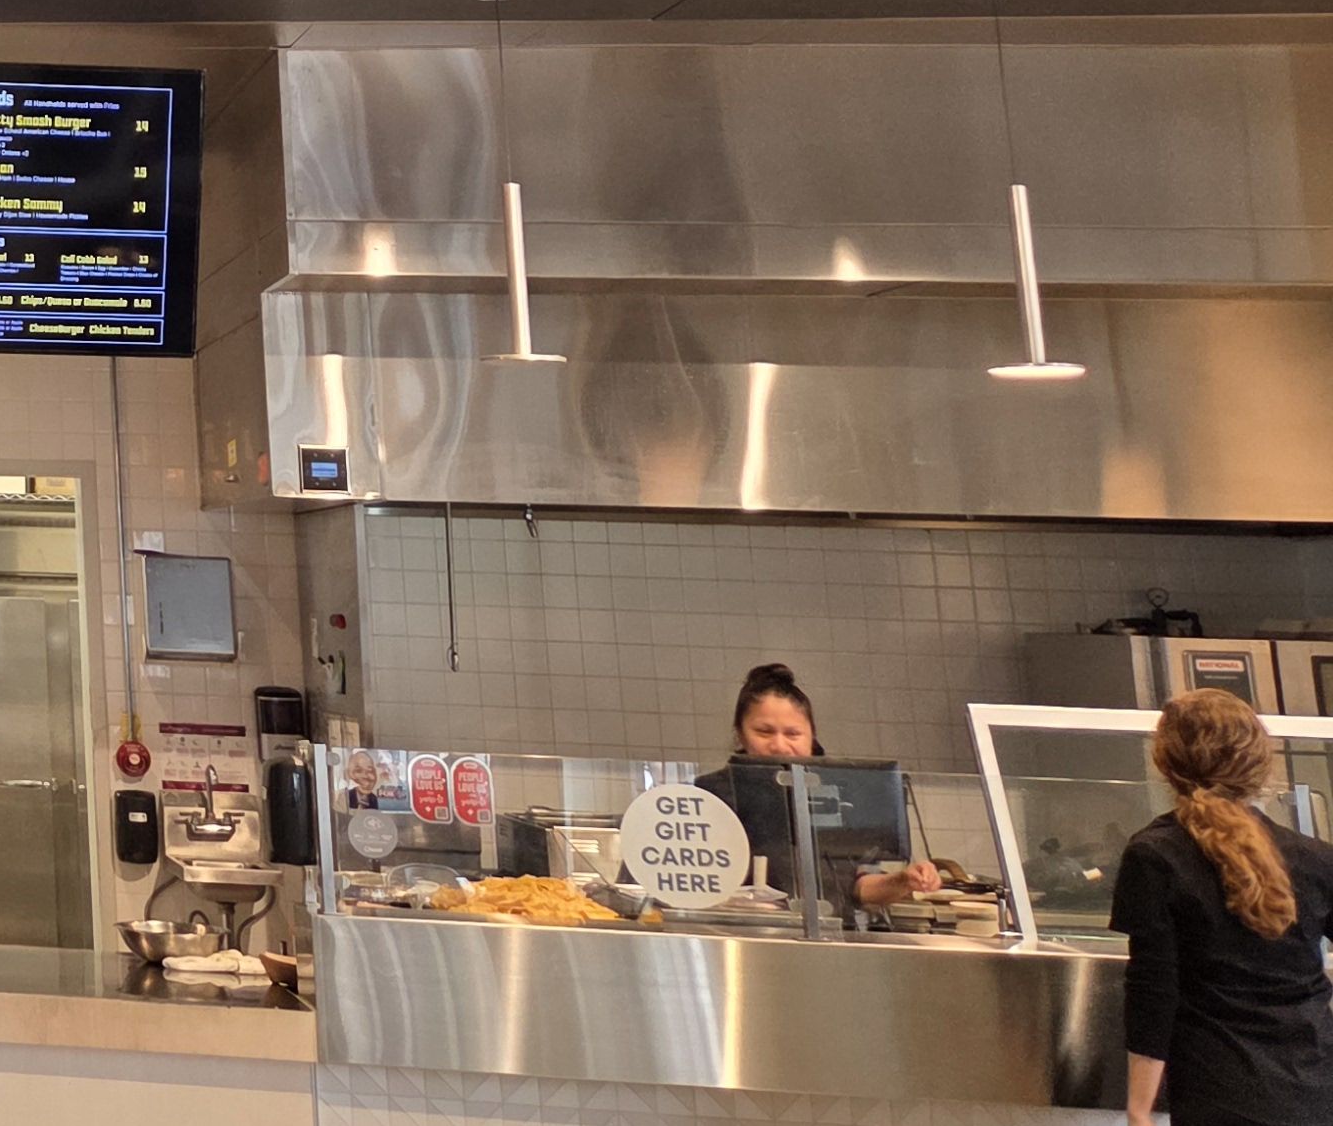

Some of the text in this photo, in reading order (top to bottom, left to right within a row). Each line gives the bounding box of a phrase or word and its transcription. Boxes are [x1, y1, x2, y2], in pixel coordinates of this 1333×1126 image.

[16, 114, 52, 127] Smash
[54, 115, 91, 131] Burger
[416, 769, 442, 780] PEOPLE
[656, 796, 704, 816] GET
[655, 821, 711, 842] GIFT
[641, 846, 731, 868] CARDS
[657, 872, 721, 893] HERE
